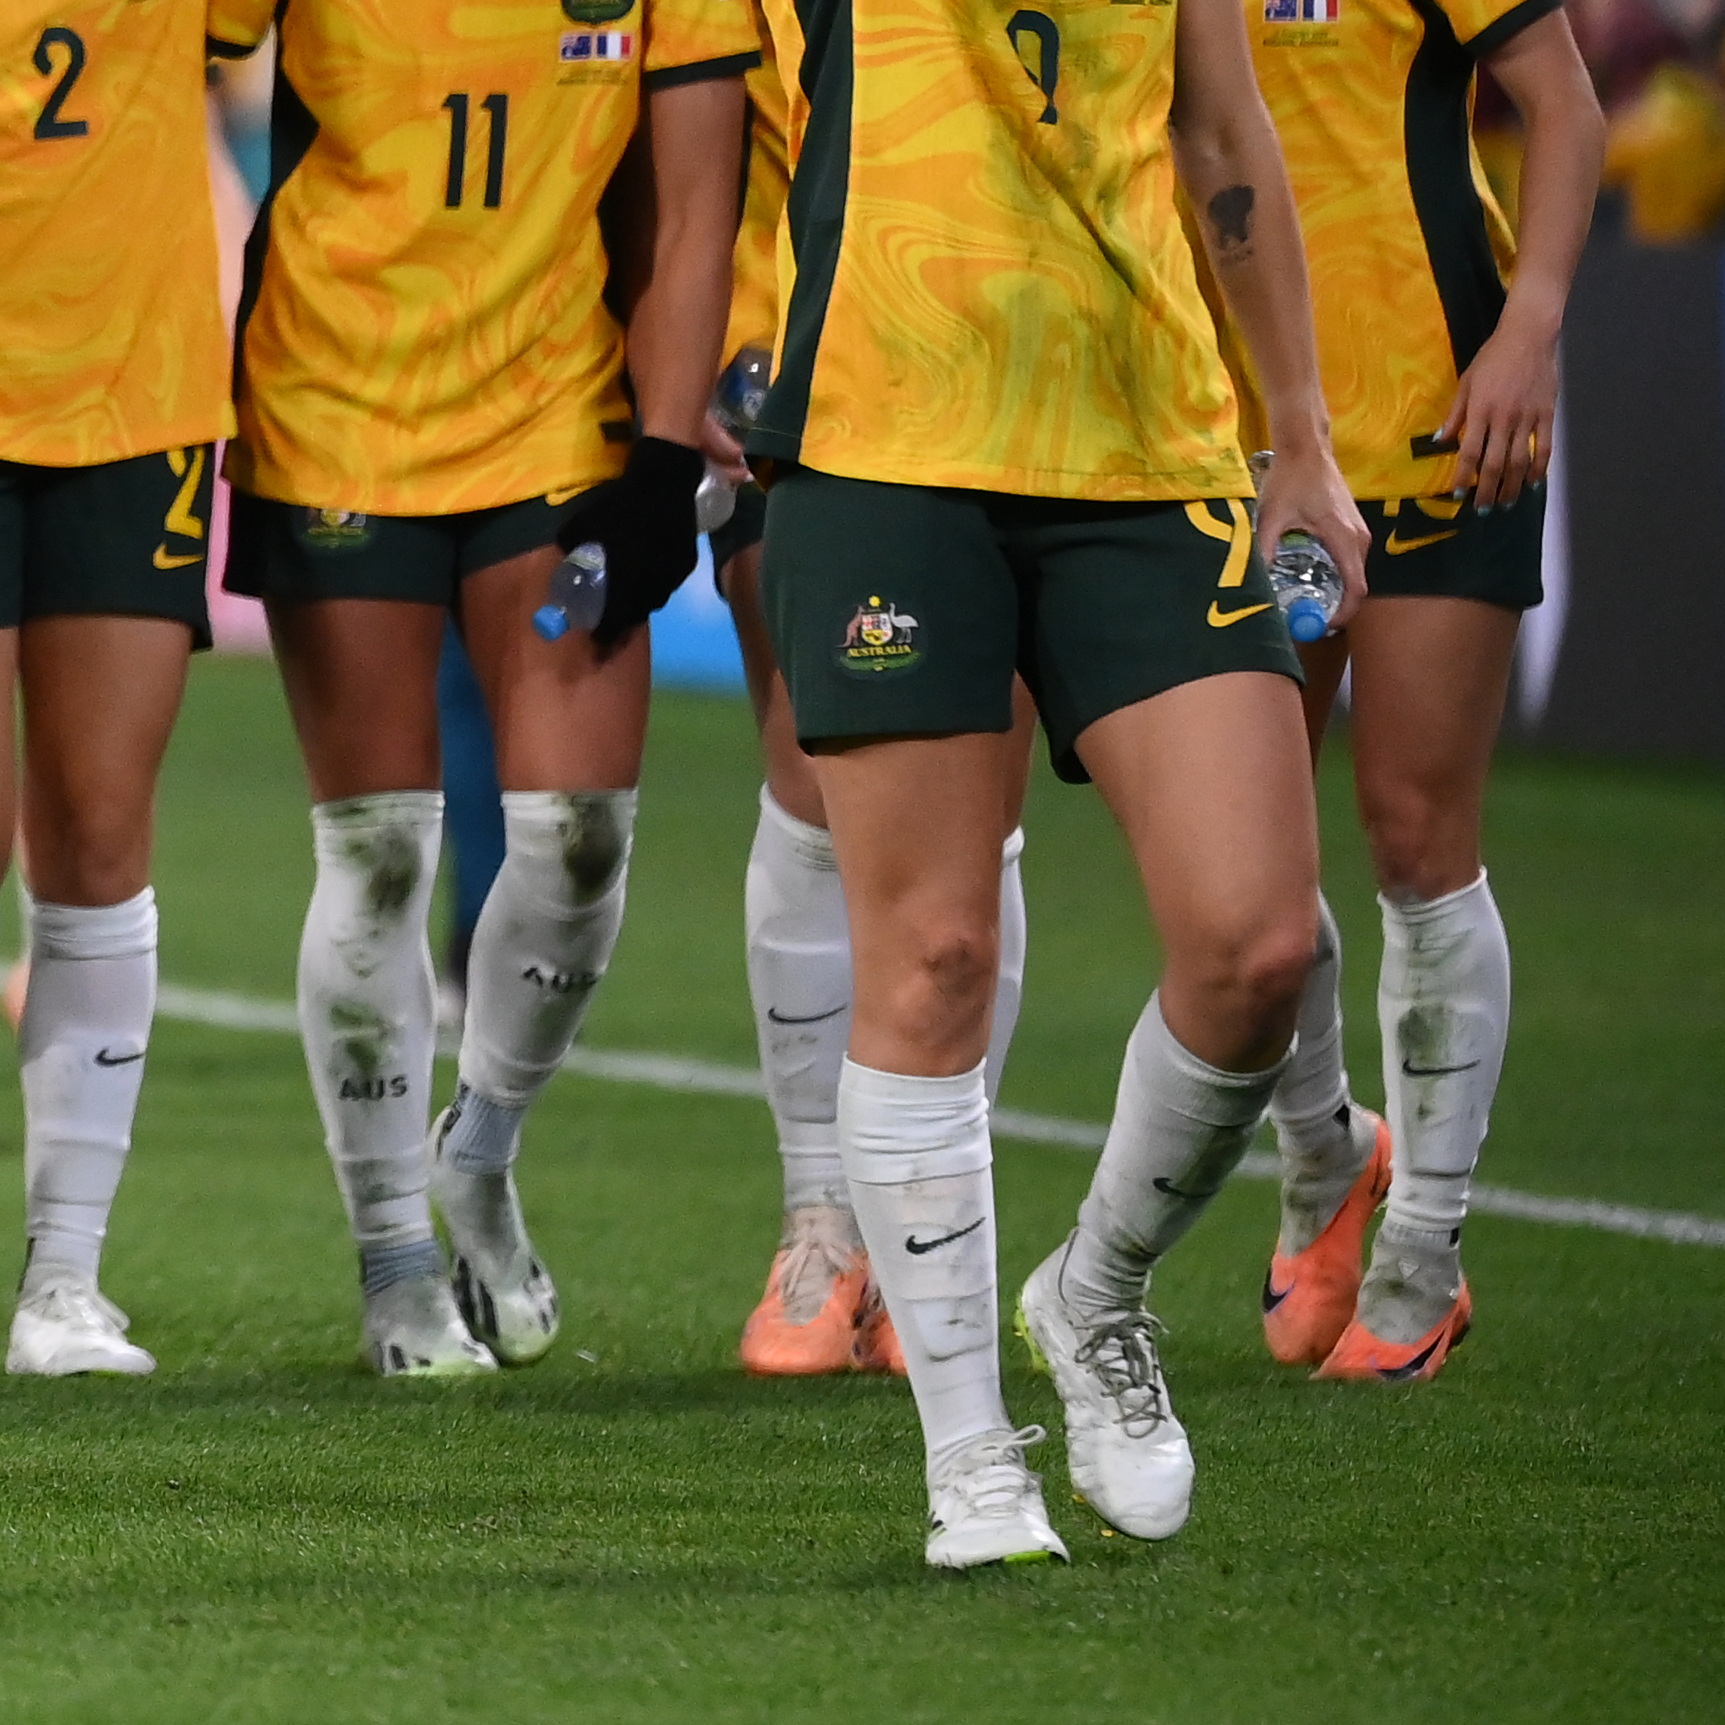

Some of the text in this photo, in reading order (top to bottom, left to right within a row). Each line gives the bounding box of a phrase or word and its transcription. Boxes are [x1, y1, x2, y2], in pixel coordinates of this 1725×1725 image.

[31, 26, 90, 139] 2
[440, 93, 510, 210] 11
[338, 1073, 409, 1102] AUS
